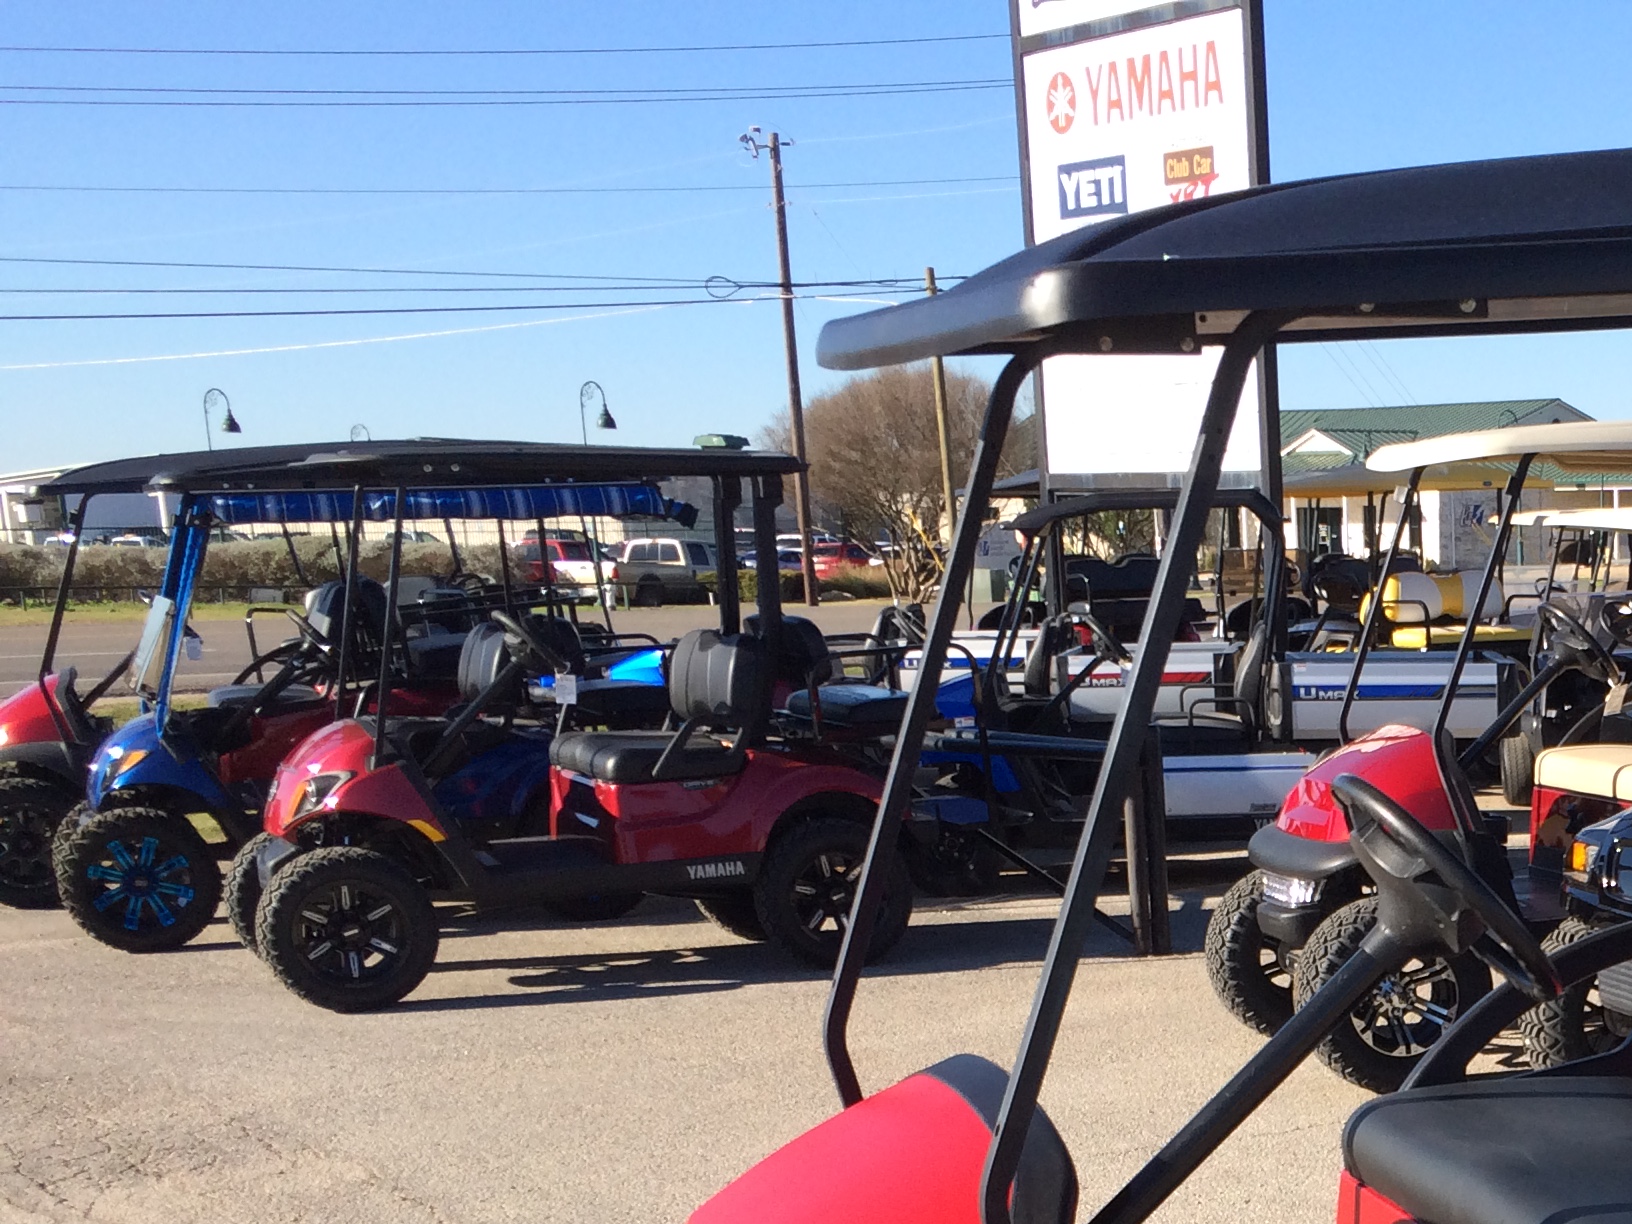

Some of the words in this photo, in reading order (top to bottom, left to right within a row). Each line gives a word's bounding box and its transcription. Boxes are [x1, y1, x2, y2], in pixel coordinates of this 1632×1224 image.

[1085, 40, 1223, 126] YAMAHA
[1166, 157, 1190, 179] Club
[1193, 154, 1212, 175] Car
[1060, 165, 1123, 210] YETI
[686, 861, 745, 880] YAMAHA
